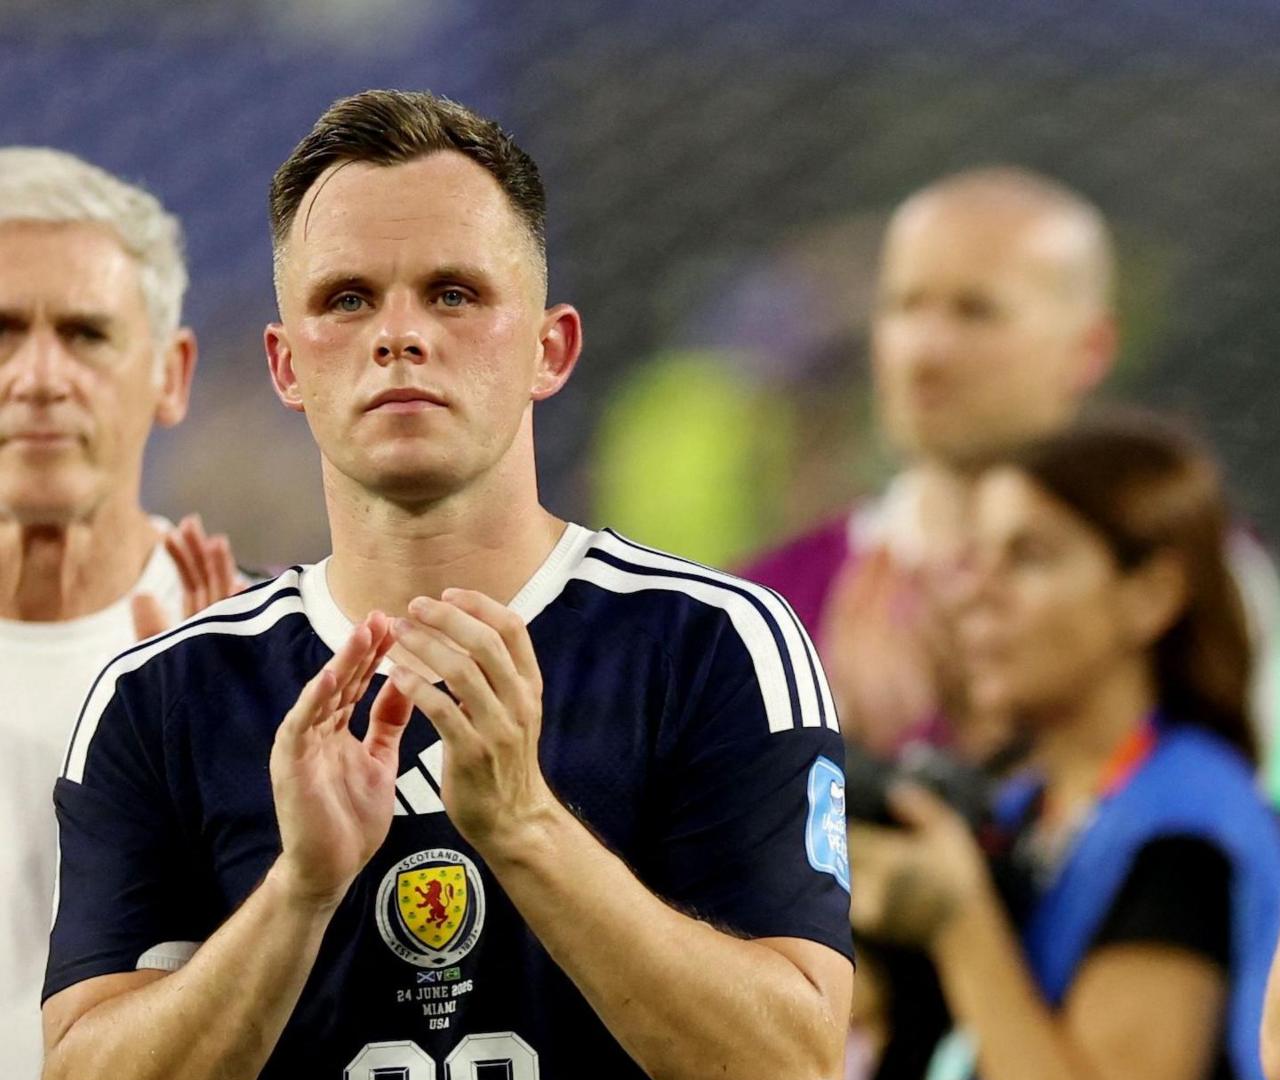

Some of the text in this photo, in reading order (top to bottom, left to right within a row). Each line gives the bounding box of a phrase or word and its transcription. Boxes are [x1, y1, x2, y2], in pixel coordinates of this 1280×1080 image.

[403, 850, 460, 868] SCOTLAND
[396, 979, 474, 1002] 24 JUNE 2026
[422, 1000, 457, 1015] MIAMI
[429, 1017, 450, 1030] USA
